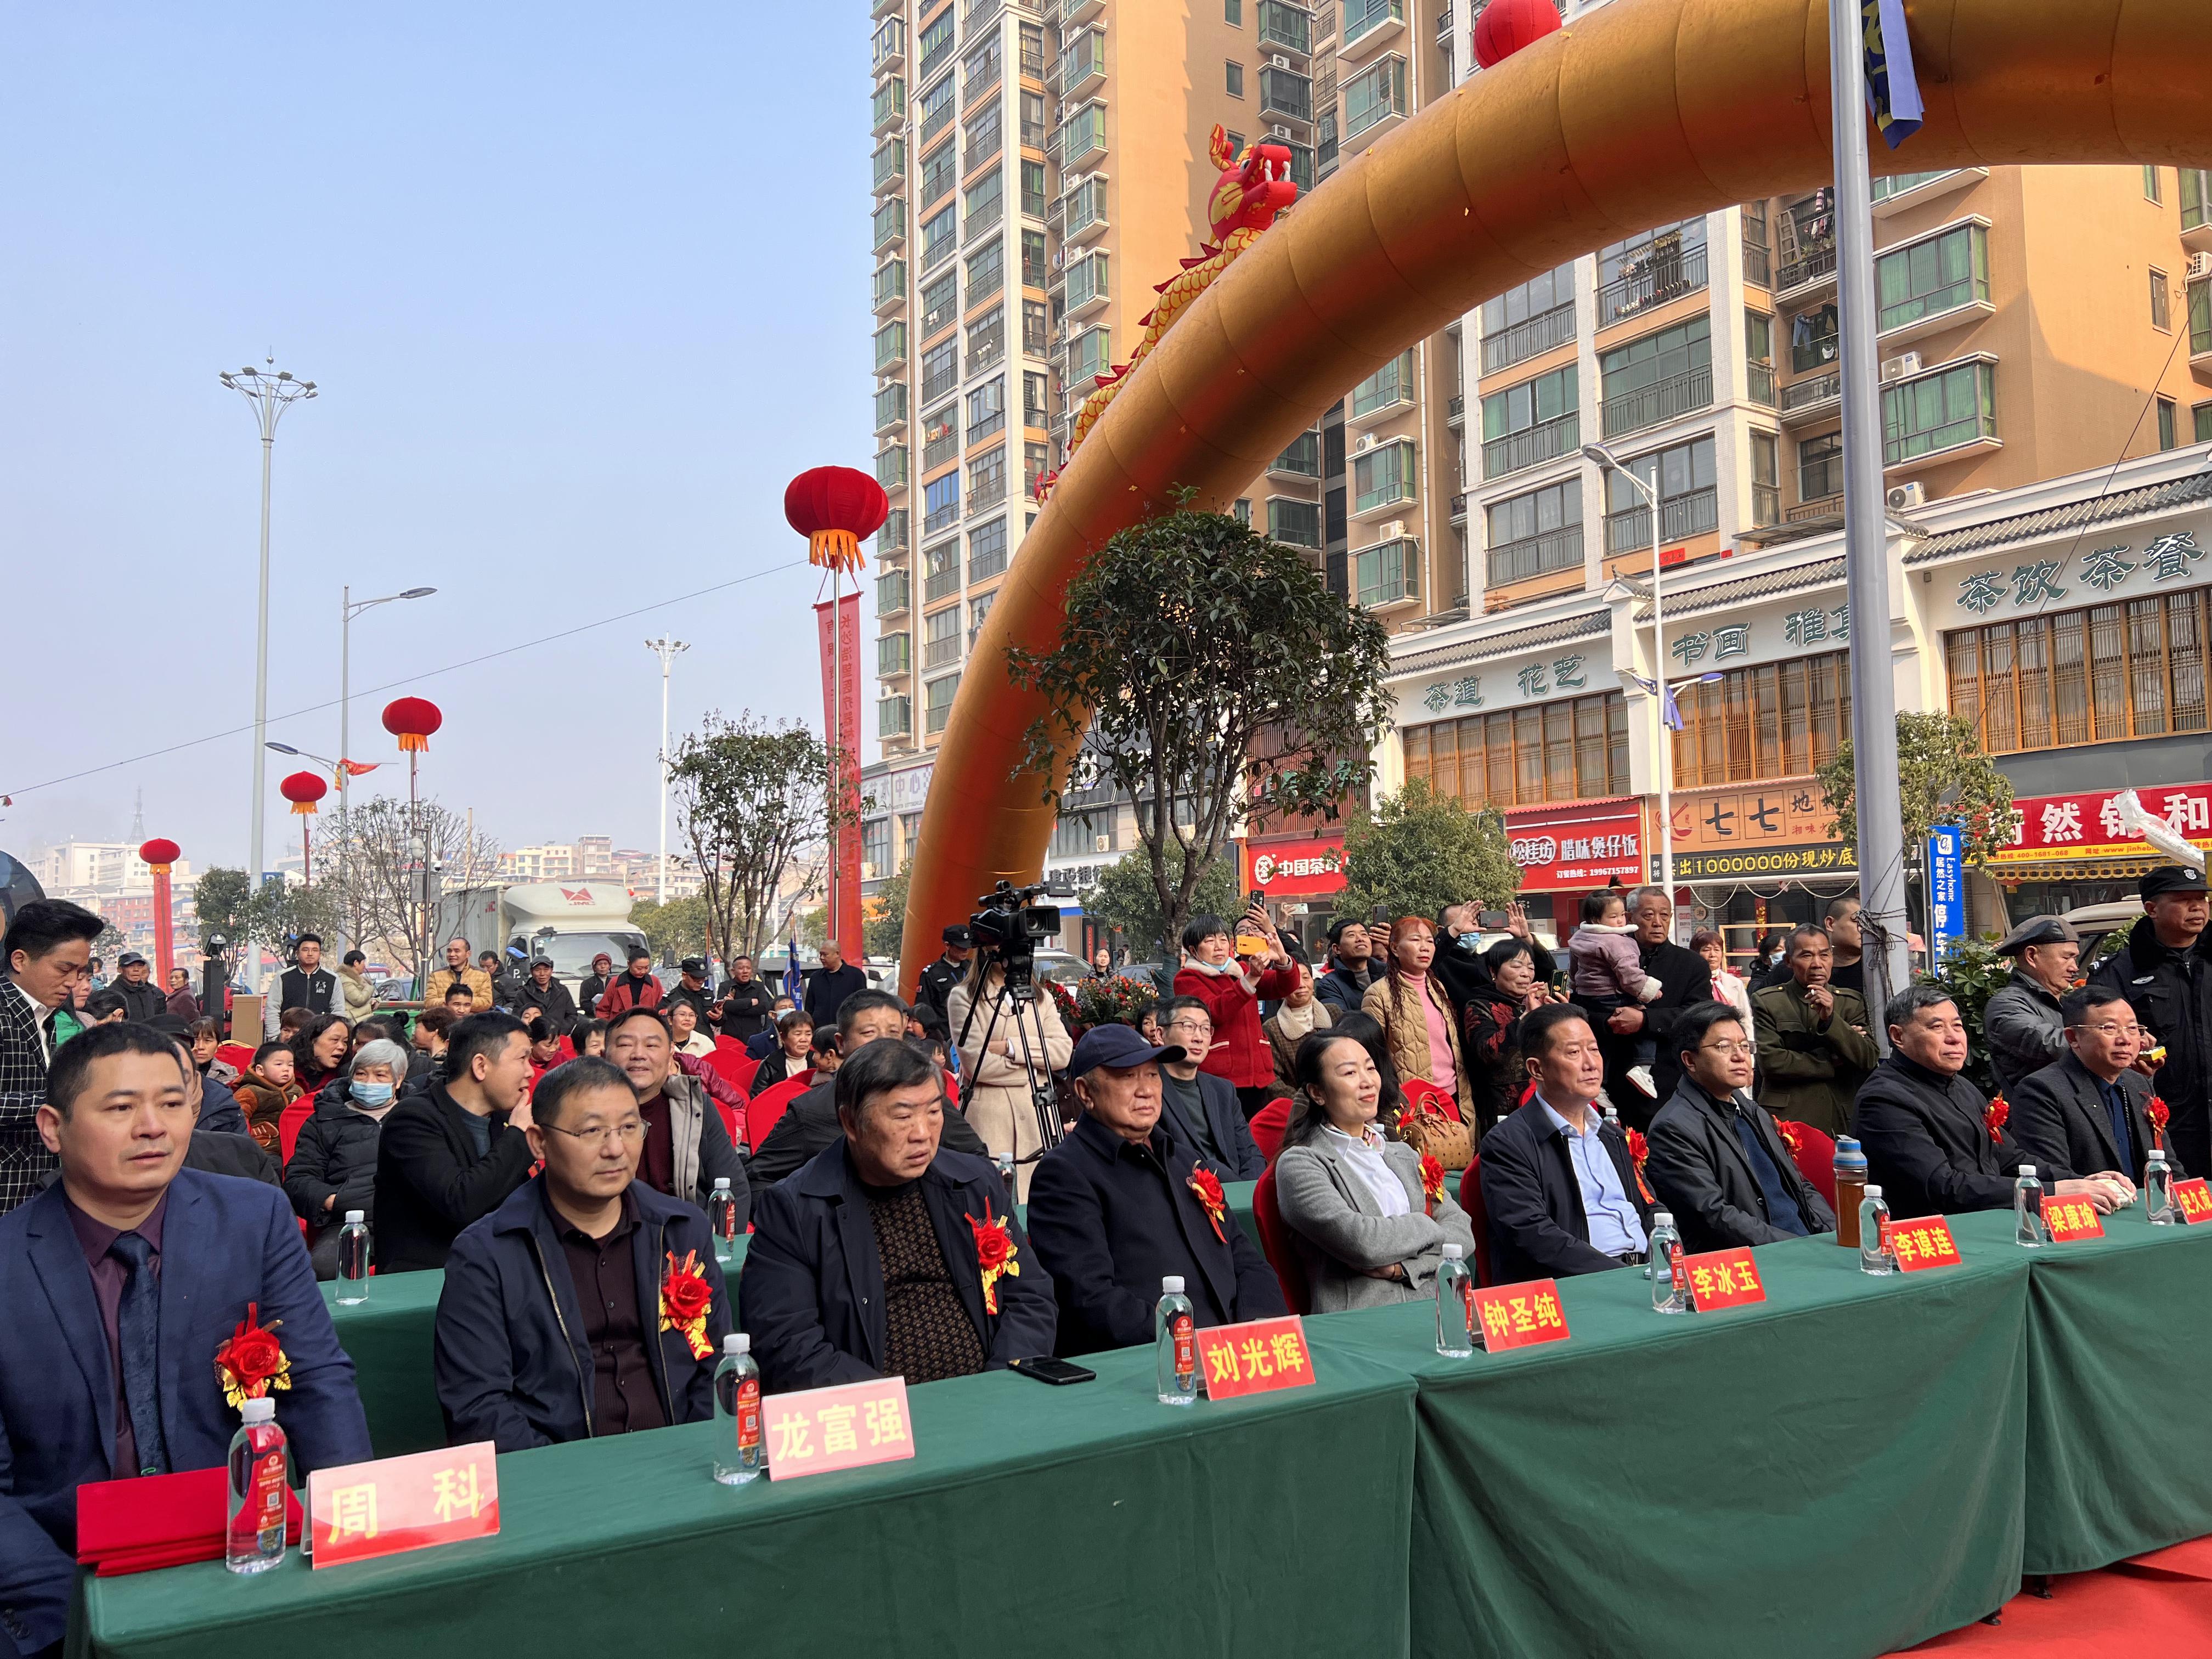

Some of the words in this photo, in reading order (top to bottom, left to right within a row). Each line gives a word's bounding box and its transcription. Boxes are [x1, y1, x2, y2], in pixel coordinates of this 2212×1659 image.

[1956, 560, 2068, 614] 茶饮
[2079, 531, 2205, 591] 茶餐
[1671, 622, 1751, 667] 书画
[1423, 675, 1483, 713] 茶道
[1517, 654, 1585, 697] 花艺
[1705, 798, 1780, 836] 七七
[1513, 843, 1553, 860] 松桂坊
[1561, 834, 1639, 860] 腊味煲仔饭
[1590, 866, 1639, 877] 19967157897
[1936, 857, 1946, 901] 居然之家
[1946, 857, 1956, 902] Easyhome
[2048, 1201, 2098, 1233] 梁康瑜
[1692, 1261, 1758, 1299] 李冰玉
[1483, 1292, 1561, 1337] 钟圣纯
[1207, 1332, 1304, 1384] 刘光辉
[771, 1397, 906, 1462] 龙富强
